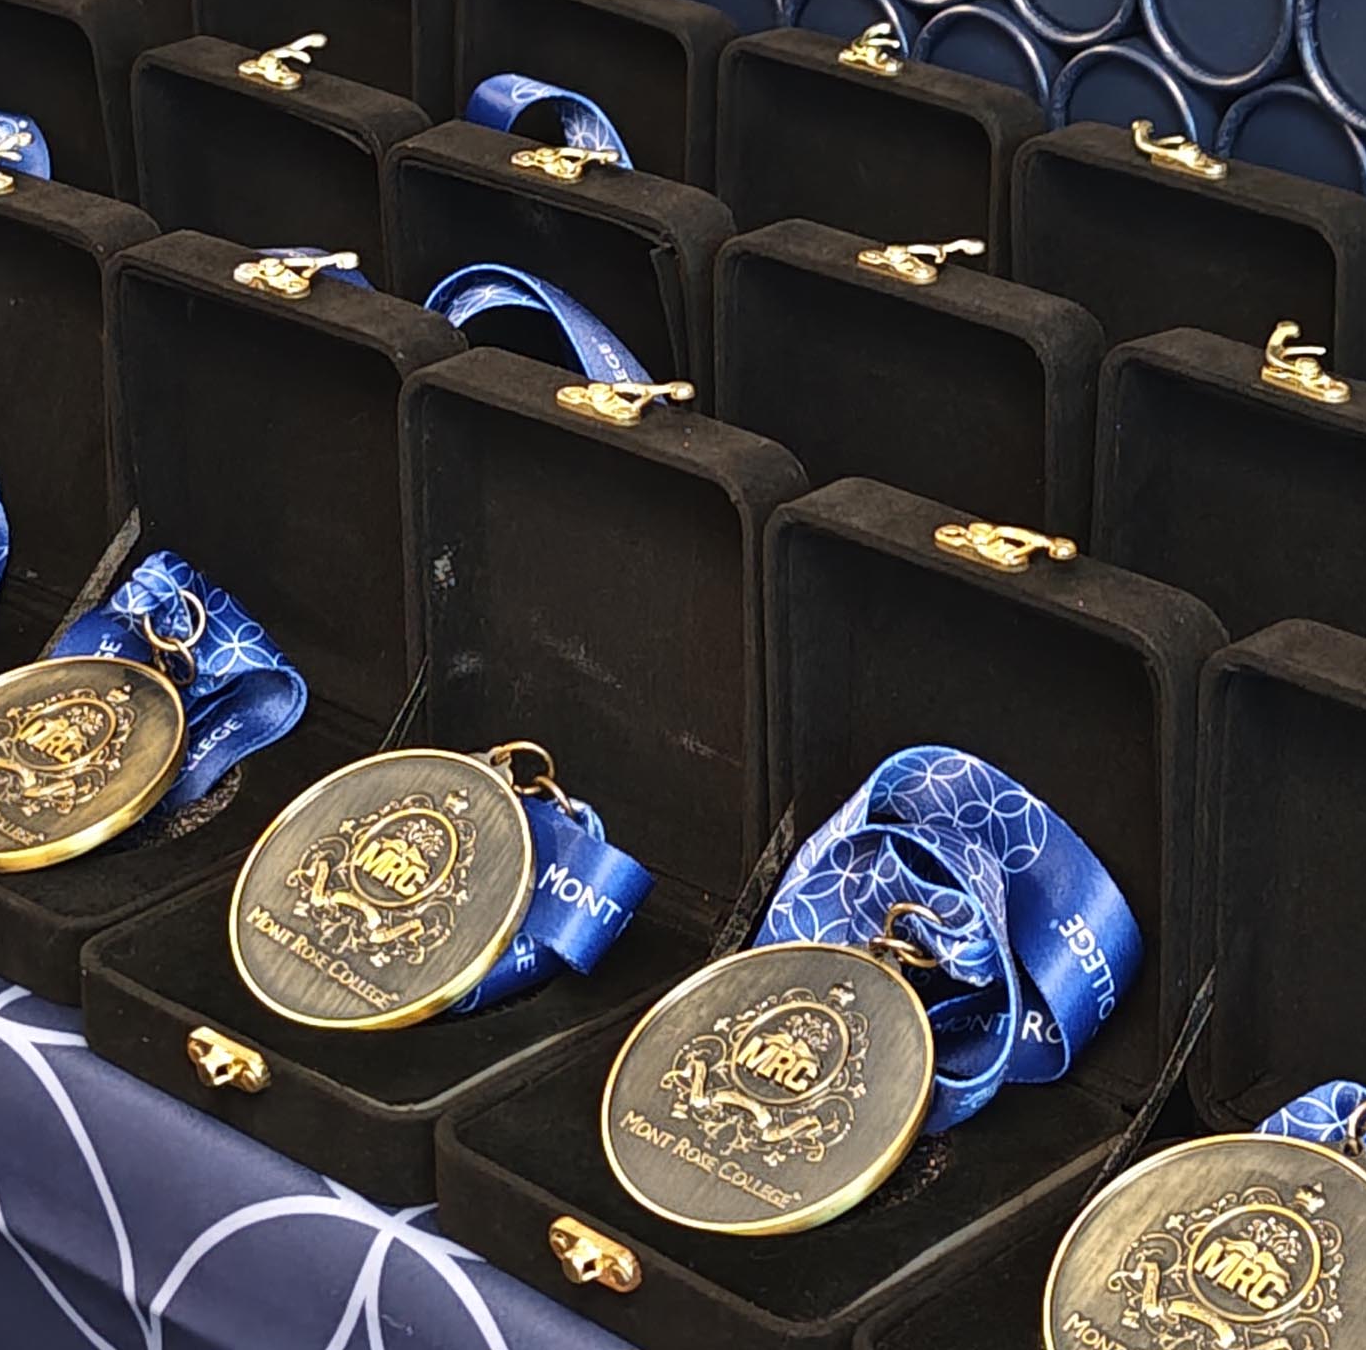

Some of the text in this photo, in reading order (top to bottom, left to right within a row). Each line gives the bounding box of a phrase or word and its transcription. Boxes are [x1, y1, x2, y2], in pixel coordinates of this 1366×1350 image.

[355, 839, 428, 897] MRC
[538, 863, 623, 925] MONT
[246, 905, 394, 1011] MONT ROSE COLLEGE
[1057, 913, 1116, 1022] OLLEGE
[737, 1034, 821, 1093] MRC
[619, 1110, 794, 1210] MONT ROSE COLLEGE
[1194, 1240, 1287, 1312] MRC
